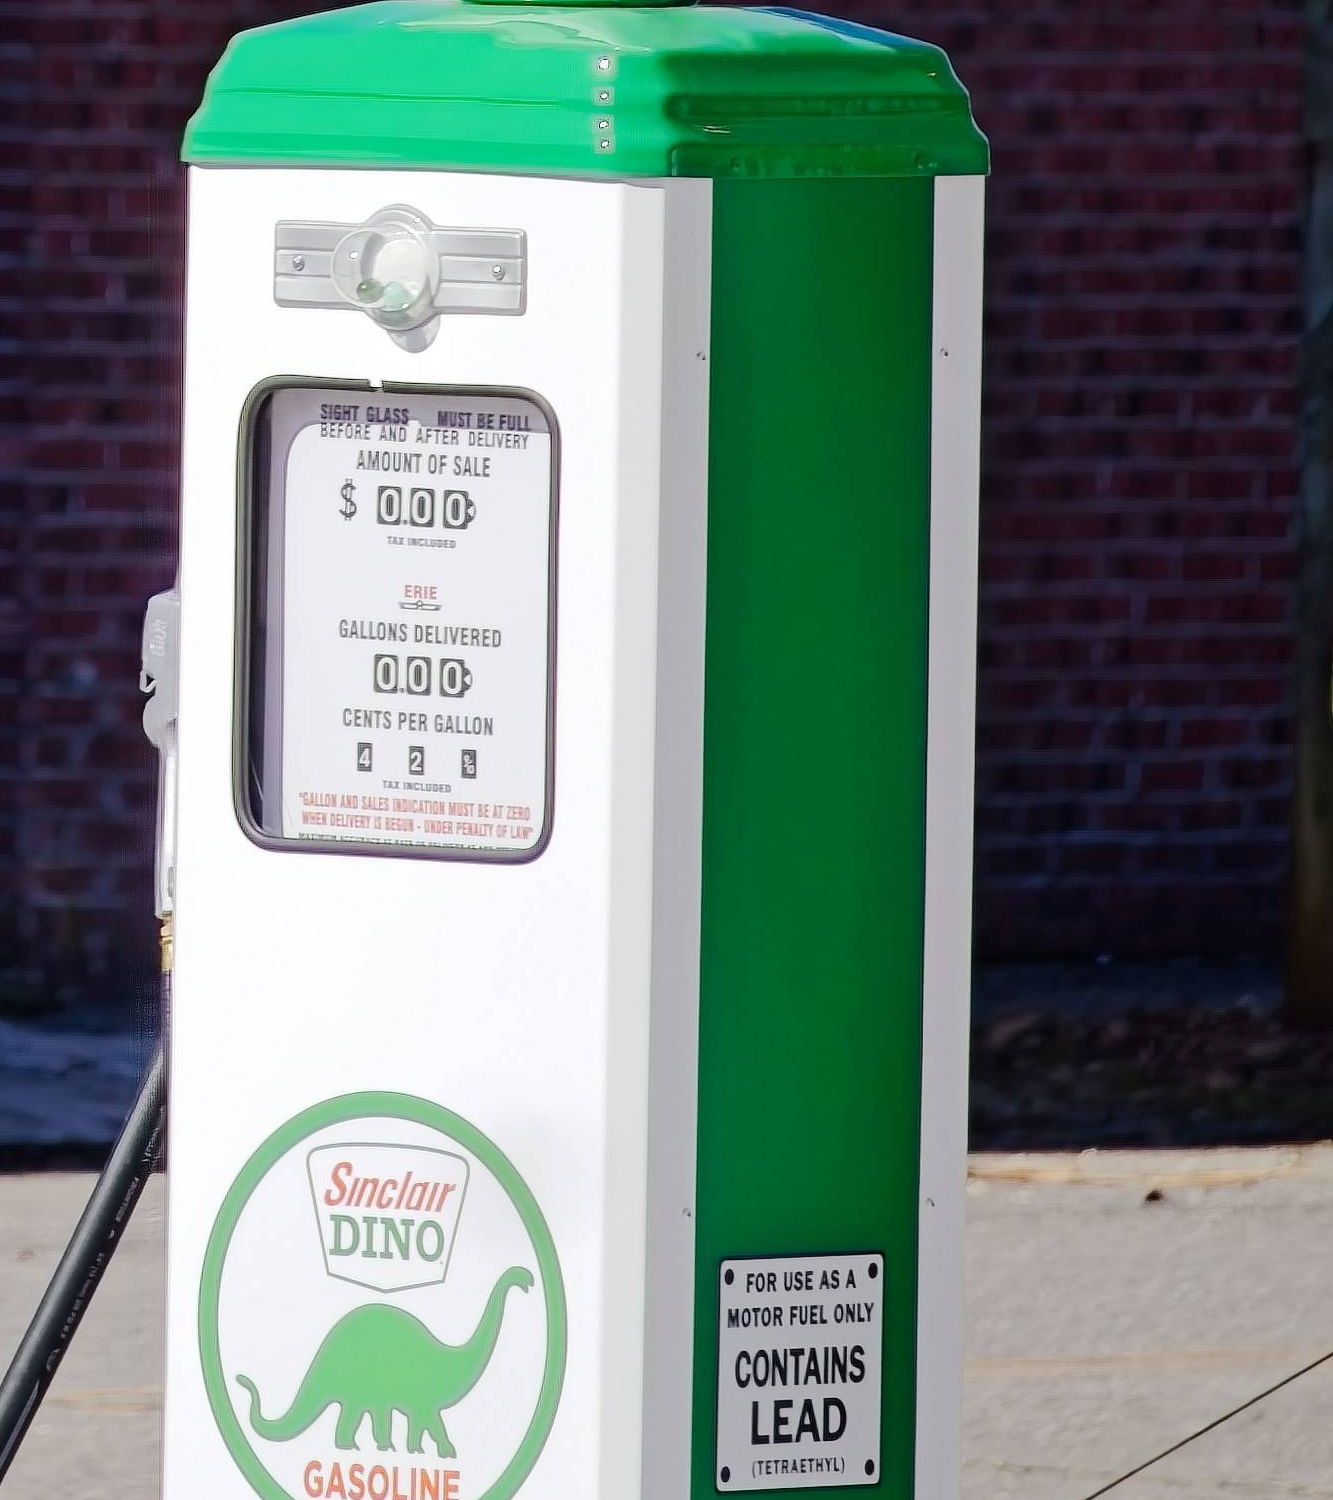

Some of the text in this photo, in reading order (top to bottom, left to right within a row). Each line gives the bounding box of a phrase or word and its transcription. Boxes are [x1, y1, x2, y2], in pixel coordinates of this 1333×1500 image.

[320, 404, 532, 431] SIGHT GLASS MUST BE FULL
[320, 422, 530, 450] BEFORE AND AFTER DELIVERY
[356, 449, 492, 478] AMOUNT OF SALE
[386, 535, 457, 549] TAX INCLUDED
[404, 584, 438, 600] ERIE
[339, 619, 503, 648] GALLONS DELIVERED
[342, 707, 494, 736] CENTS PER GALLON
[382, 779, 452, 794] TAX INCLUDED
[340, 794, 359, 809] AND
[361, 796, 390, 812] SALES
[448, 801, 475, 819] MUST
[477, 804, 490, 819] BE
[492, 805, 505, 820] AT
[506, 805, 532, 822] ZERO
[301, 811, 327, 826] WHEN
[329, 813, 372, 830] DELIVERY
[373, 816, 383, 831] IS
[455, 822, 493, 839] PENALTY
[324, 1162, 456, 1213] Sinclair
[329, 1214, 445, 1262] DINO
[746, 1269, 857, 1294] FOR USE AS A
[727, 1302, 875, 1329] MOTOR FUEL ONLY
[735, 1345, 866, 1389] CONTAINS
[751, 1397, 847, 1446] LEAD
[751, 1457, 846, 1479] (TETRAETHYL)
